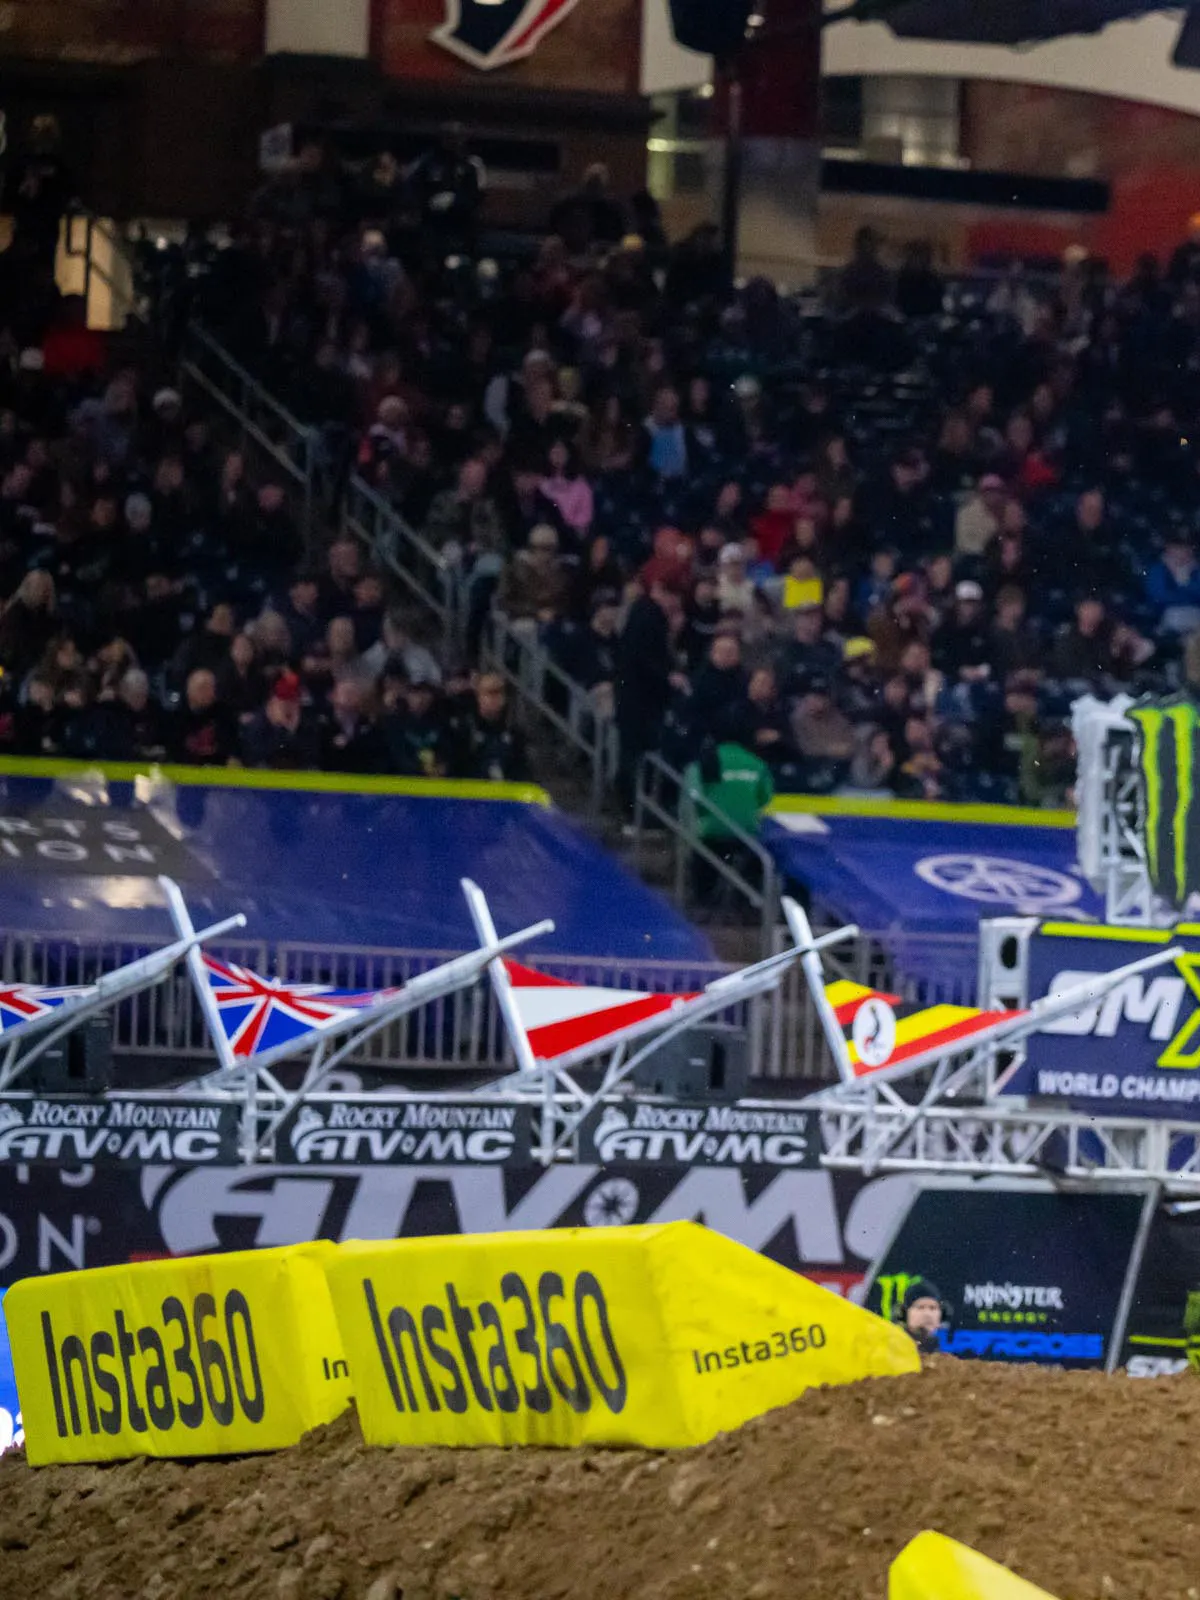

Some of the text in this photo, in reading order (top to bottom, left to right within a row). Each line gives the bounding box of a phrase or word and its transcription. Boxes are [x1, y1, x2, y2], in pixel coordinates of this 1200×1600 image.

[1038, 1070, 1118, 1097] WORLD
[28, 1100, 222, 1129] ROCKY MOUNTAIN
[328, 1103, 516, 1129] ROCKY MOUNTAIN
[632, 1104, 704, 1130] ROCKY
[964, 1281, 1064, 1310] MONSTER
[363, 1270, 627, 1415] Insta360
[692, 1323, 827, 1375] Insta360
[40, 1288, 265, 1438] Insta360
